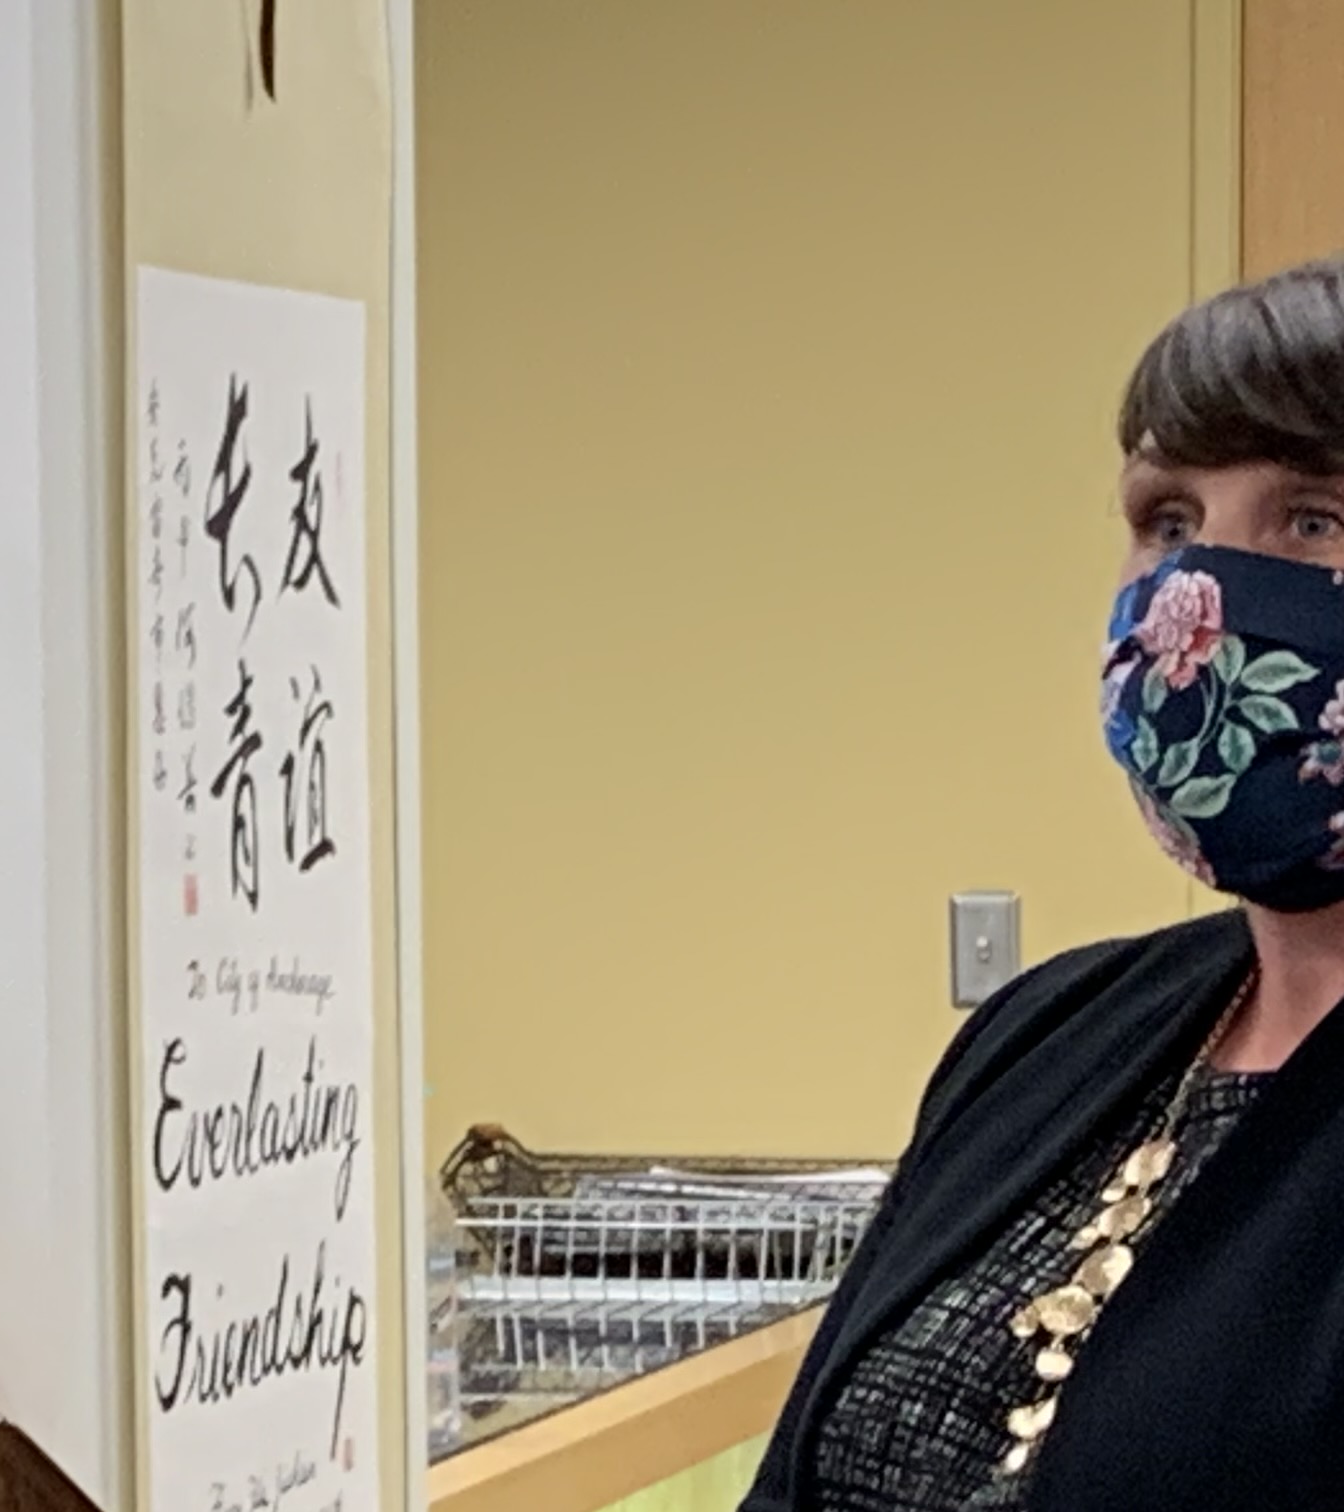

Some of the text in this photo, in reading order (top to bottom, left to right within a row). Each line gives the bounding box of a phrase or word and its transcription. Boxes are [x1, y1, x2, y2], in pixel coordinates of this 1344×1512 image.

[215, 956, 242, 1016] City
[155, 1036, 360, 1222] Everlasting
[156, 1239, 367, 1461] Friendship
